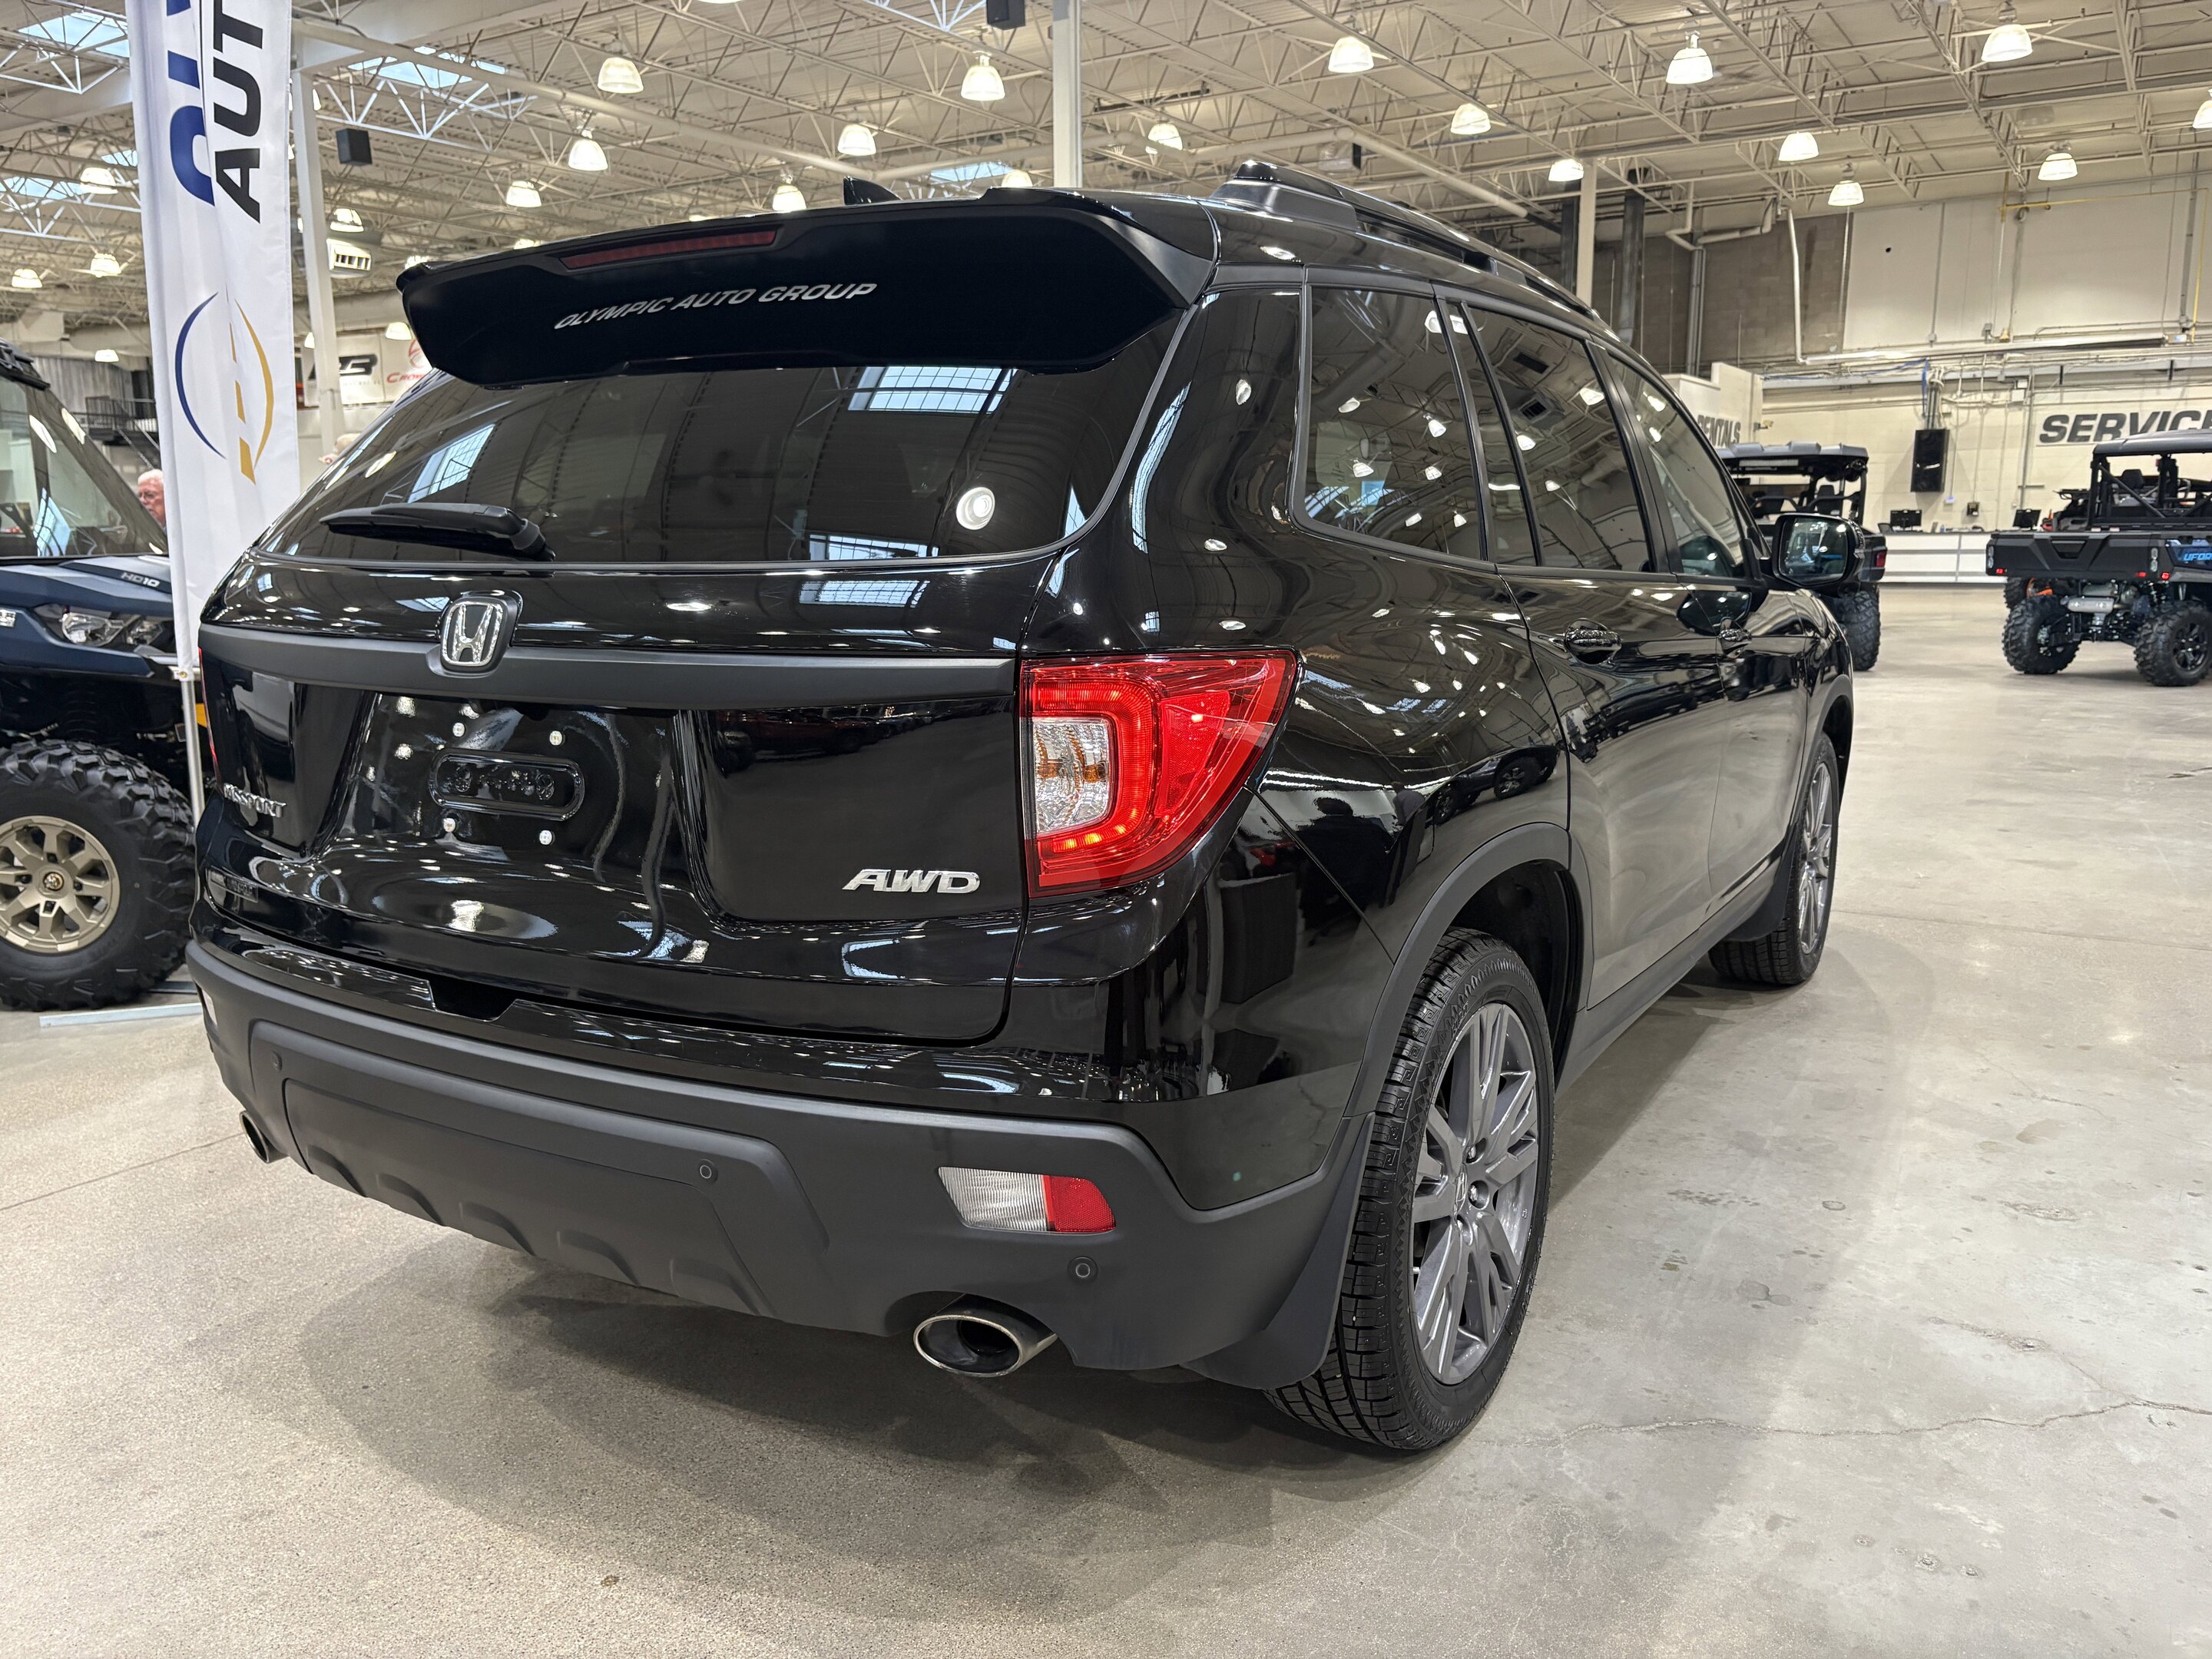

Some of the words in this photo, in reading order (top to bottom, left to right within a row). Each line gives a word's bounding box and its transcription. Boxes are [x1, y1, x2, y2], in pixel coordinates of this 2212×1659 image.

[554, 296, 674, 329] OLYMPIC
[671, 288, 757, 310] AUTO
[758, 283, 878, 303] GROUP
[2039, 410, 2212, 443] SERVIC
[842, 868, 981, 894] AWD
